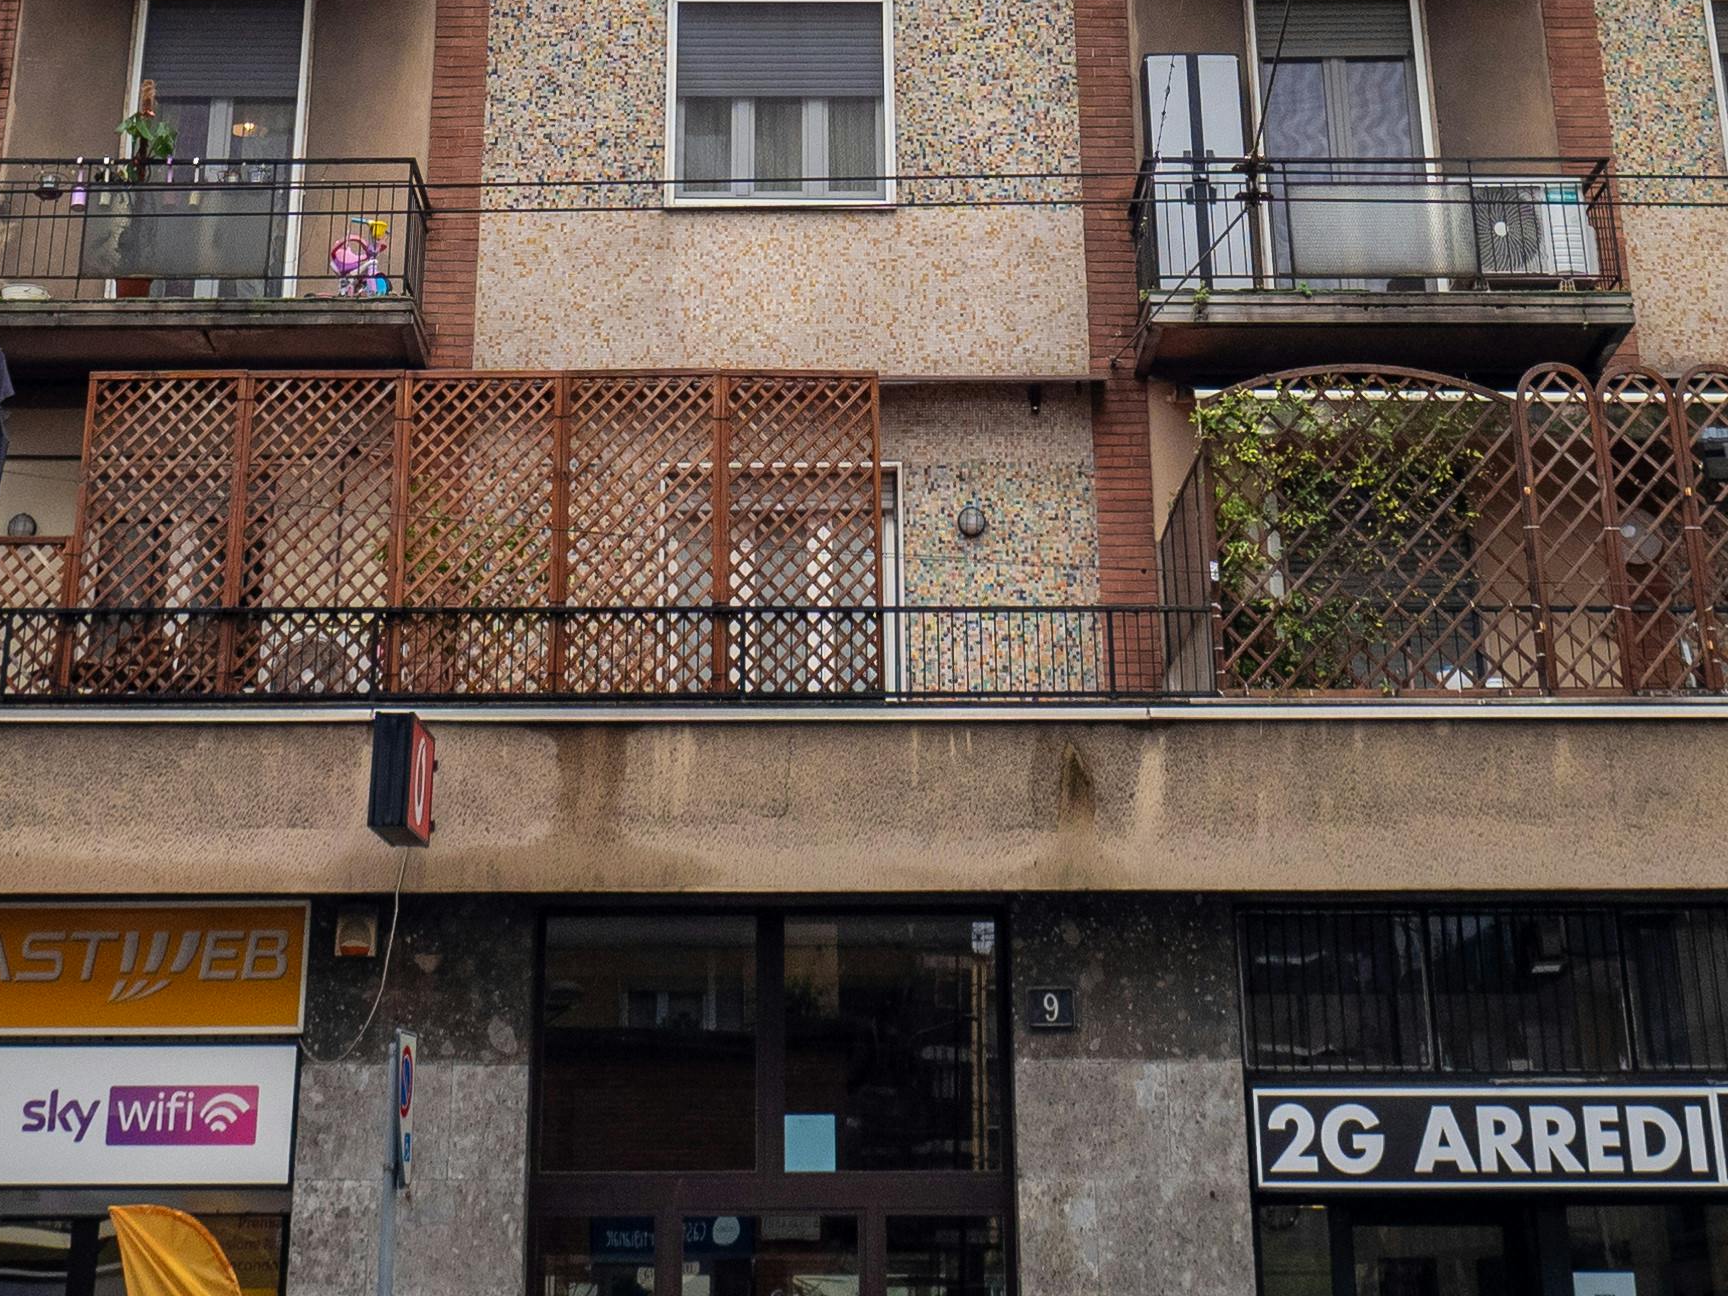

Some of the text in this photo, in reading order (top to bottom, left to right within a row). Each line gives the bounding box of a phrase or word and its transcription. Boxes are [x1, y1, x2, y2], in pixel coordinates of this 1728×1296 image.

[1043, 994, 1059, 1022] 9
[22, 1089, 194, 1142] sky wifi
[1268, 1104, 1710, 1173] 2G ARREDI
